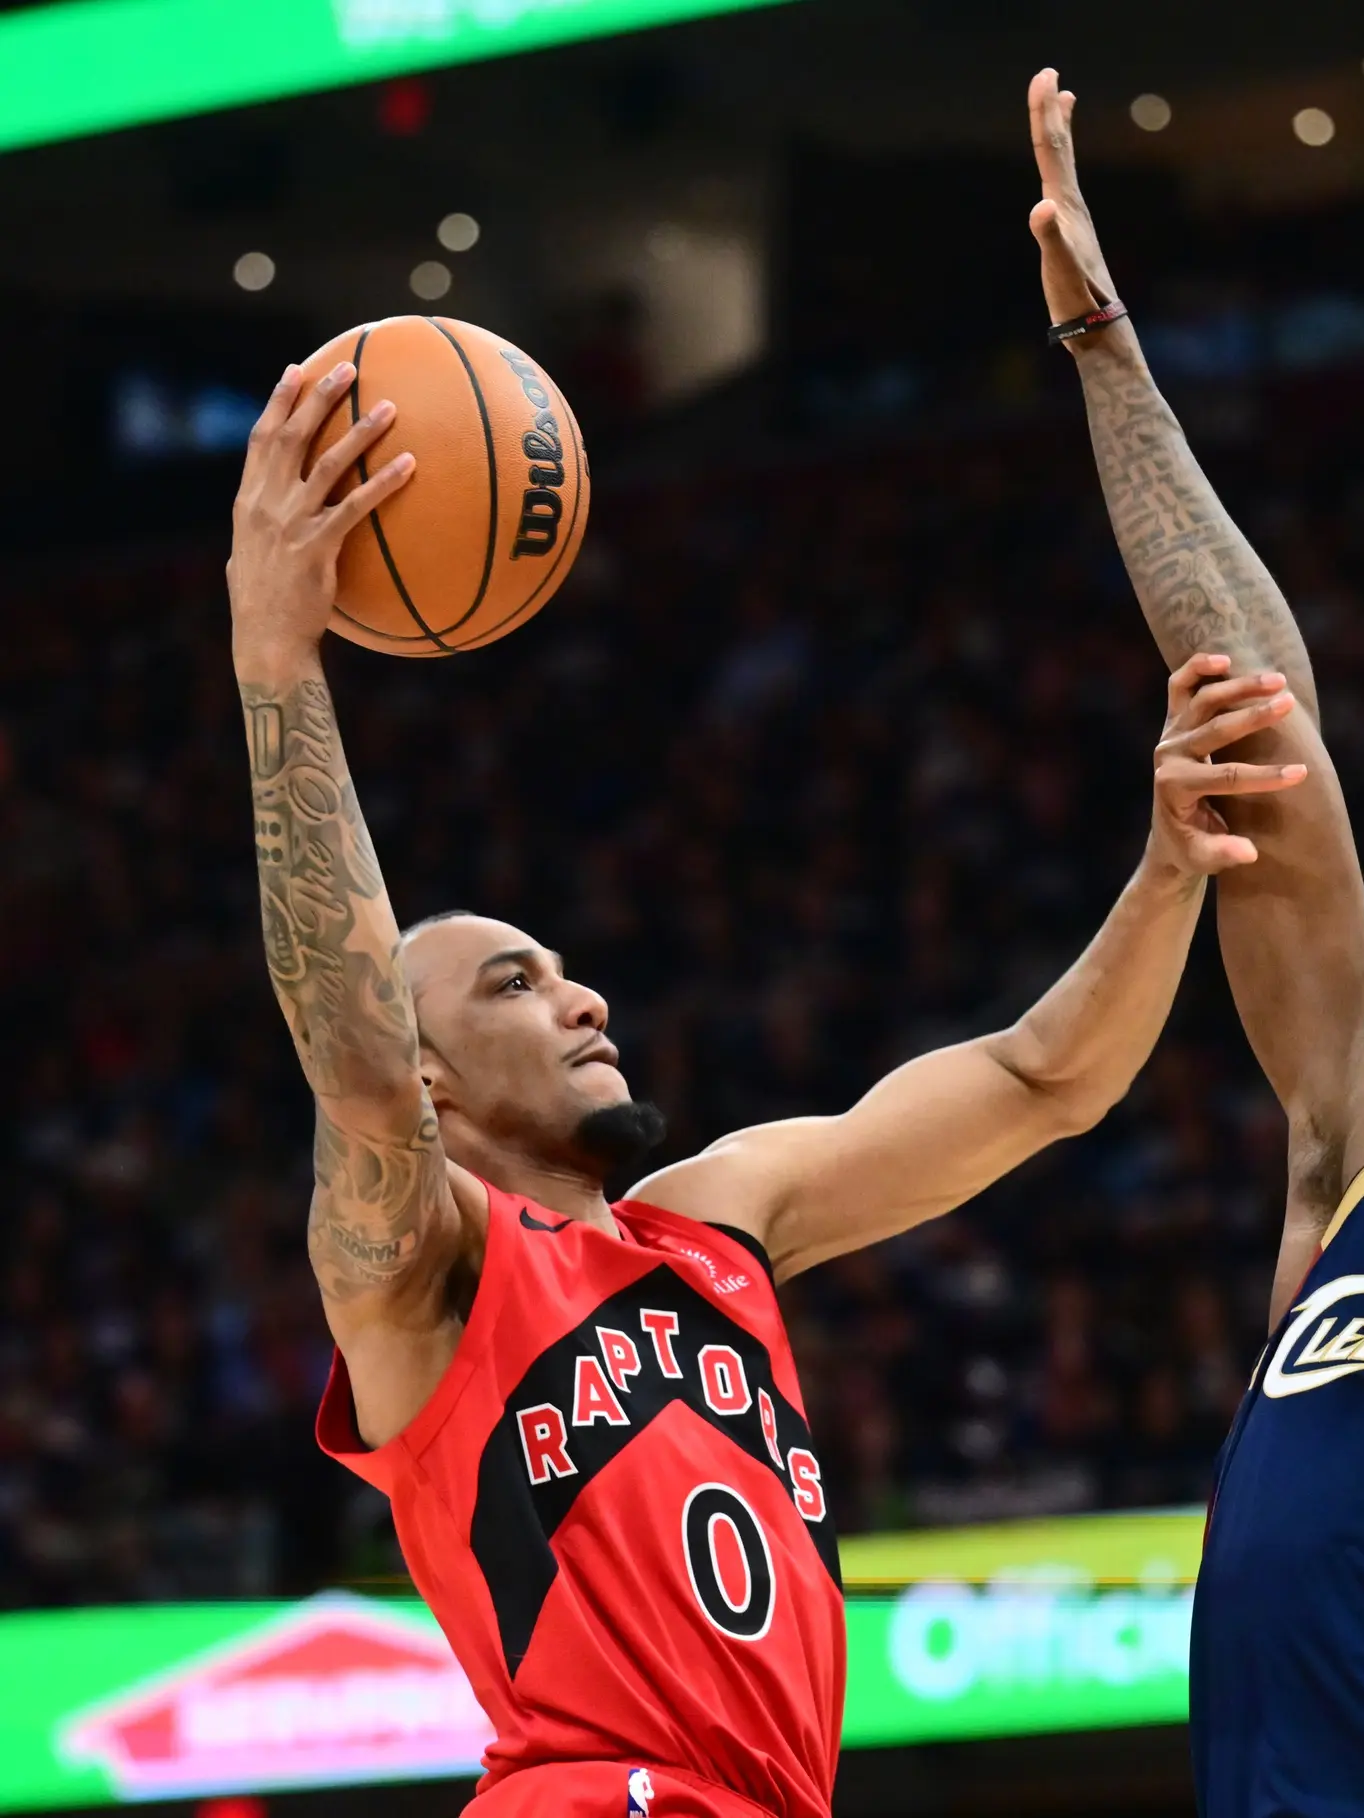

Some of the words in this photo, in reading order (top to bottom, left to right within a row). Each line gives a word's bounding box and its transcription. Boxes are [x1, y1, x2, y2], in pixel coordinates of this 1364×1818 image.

[500, 348, 565, 561] Wilson
[516, 1308, 826, 1522] RAPTORS
[681, 1482, 776, 1641] 0
[888, 1556, 1198, 1702] Offici
